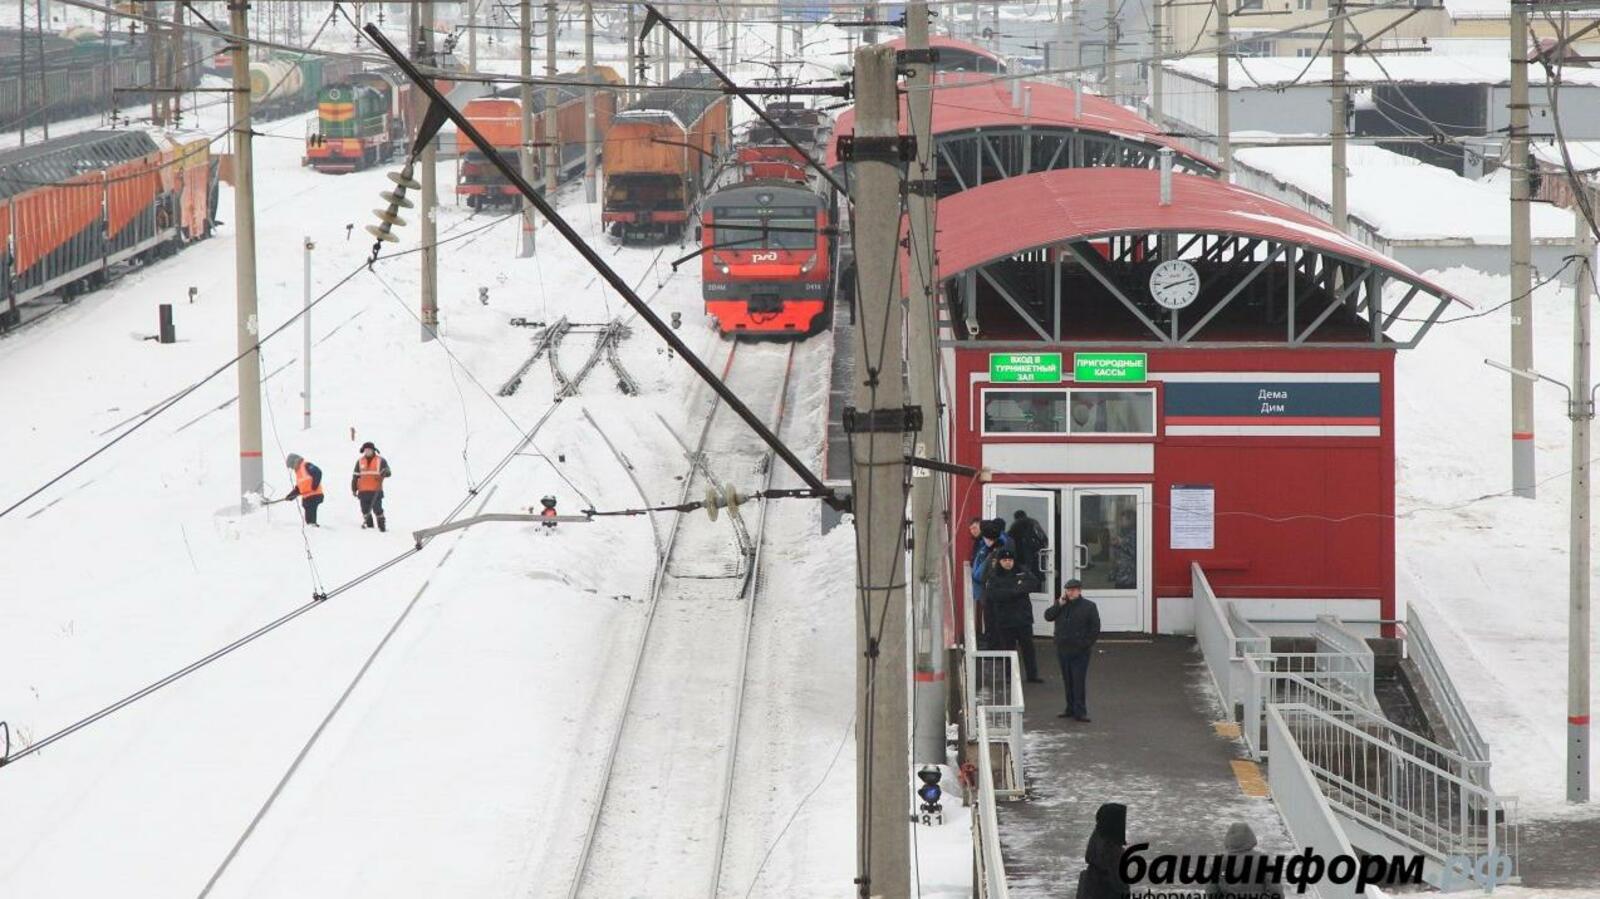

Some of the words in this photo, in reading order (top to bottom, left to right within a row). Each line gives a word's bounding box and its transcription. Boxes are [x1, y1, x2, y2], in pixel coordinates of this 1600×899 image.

[1010, 356, 1033, 364] ВХОД
[1034, 356, 1041, 364] В
[1077, 359, 1144, 368] ПРИГОРОДНЫЕ
[996, 364, 1056, 372] ТУРНИКЕТНЫЙ
[1094, 368, 1126, 377] КАССЫ
[1017, 373, 1035, 381] ЗАЛ
[1257, 388, 1288, 401] Дема
[1260, 402, 1285, 414] Дим
